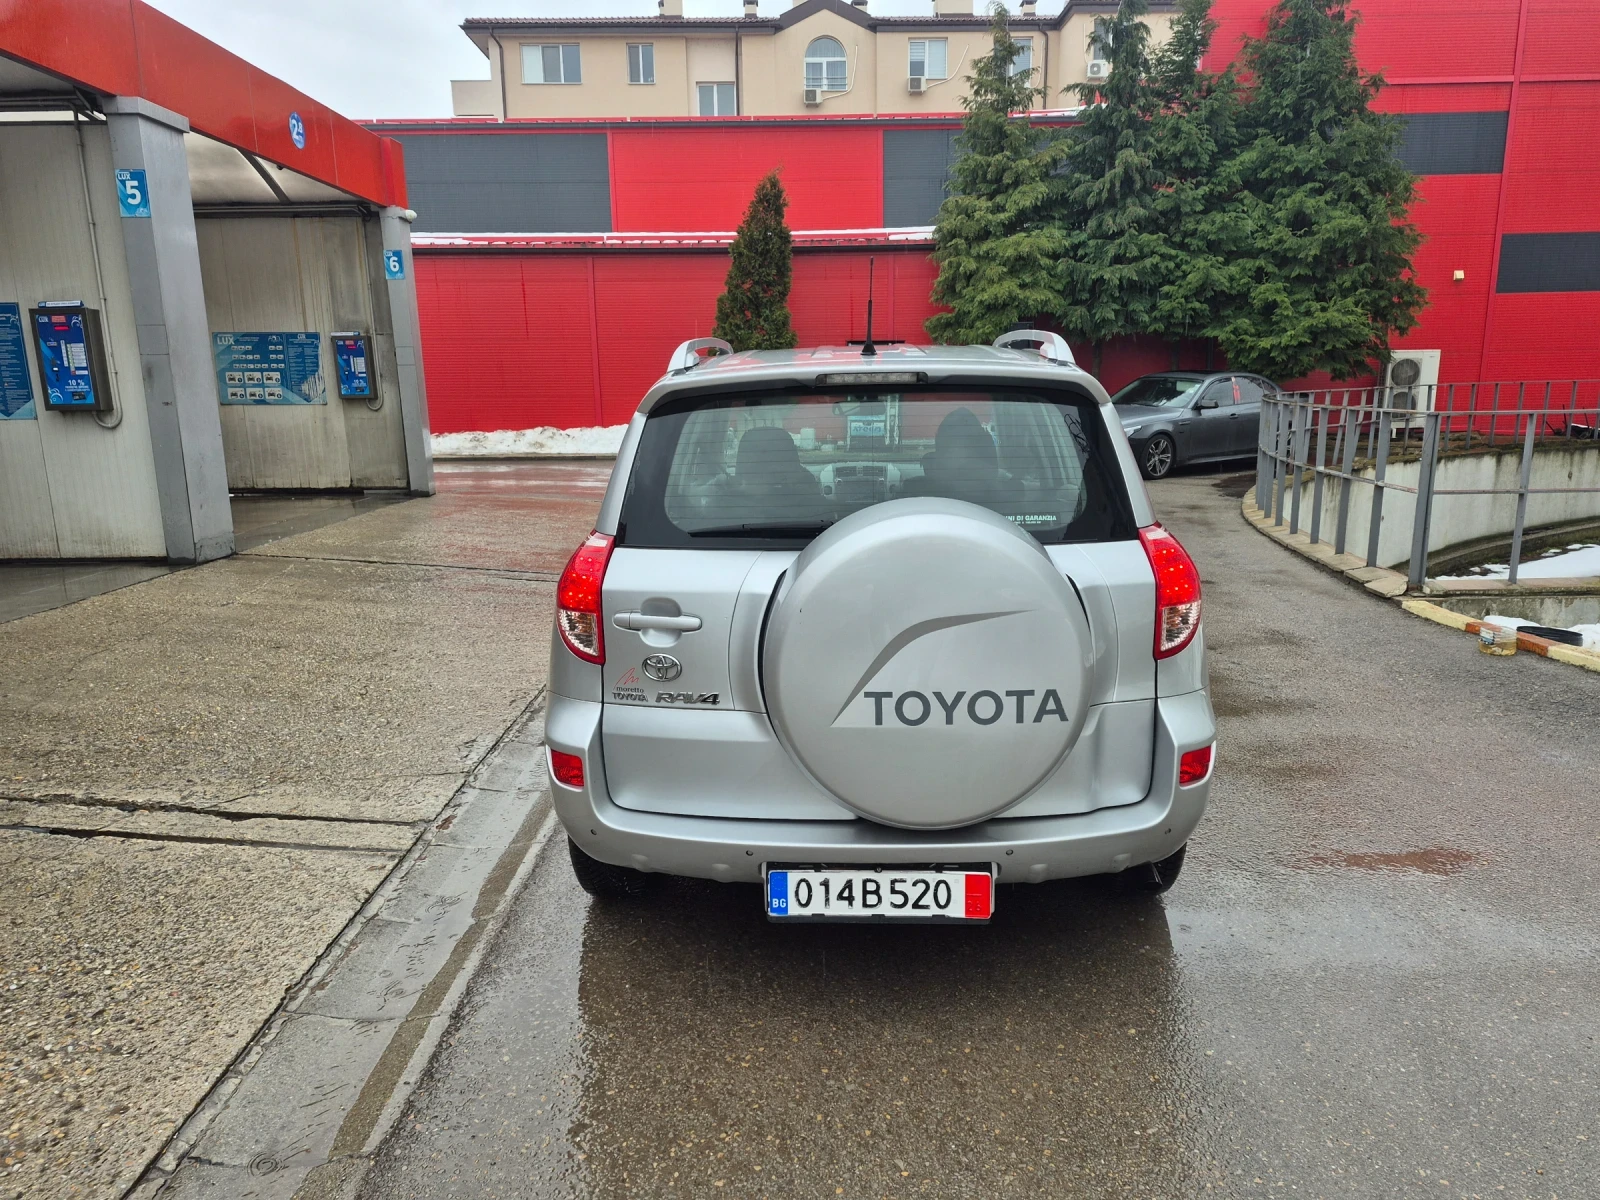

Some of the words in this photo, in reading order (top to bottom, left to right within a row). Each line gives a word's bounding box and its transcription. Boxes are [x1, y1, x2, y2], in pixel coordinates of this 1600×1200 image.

[117, 172, 131, 180] LUX
[125, 180, 142, 205] 5
[389, 256, 400, 272] 6
[217, 335, 235, 345] LUX
[612, 692, 648, 702] TOYOTA
[655, 691, 720, 705] RAV4
[863, 688, 1069, 727] TOYOTA
[794, 877, 953, 910] 014B520
[772, 898, 787, 908] BG
